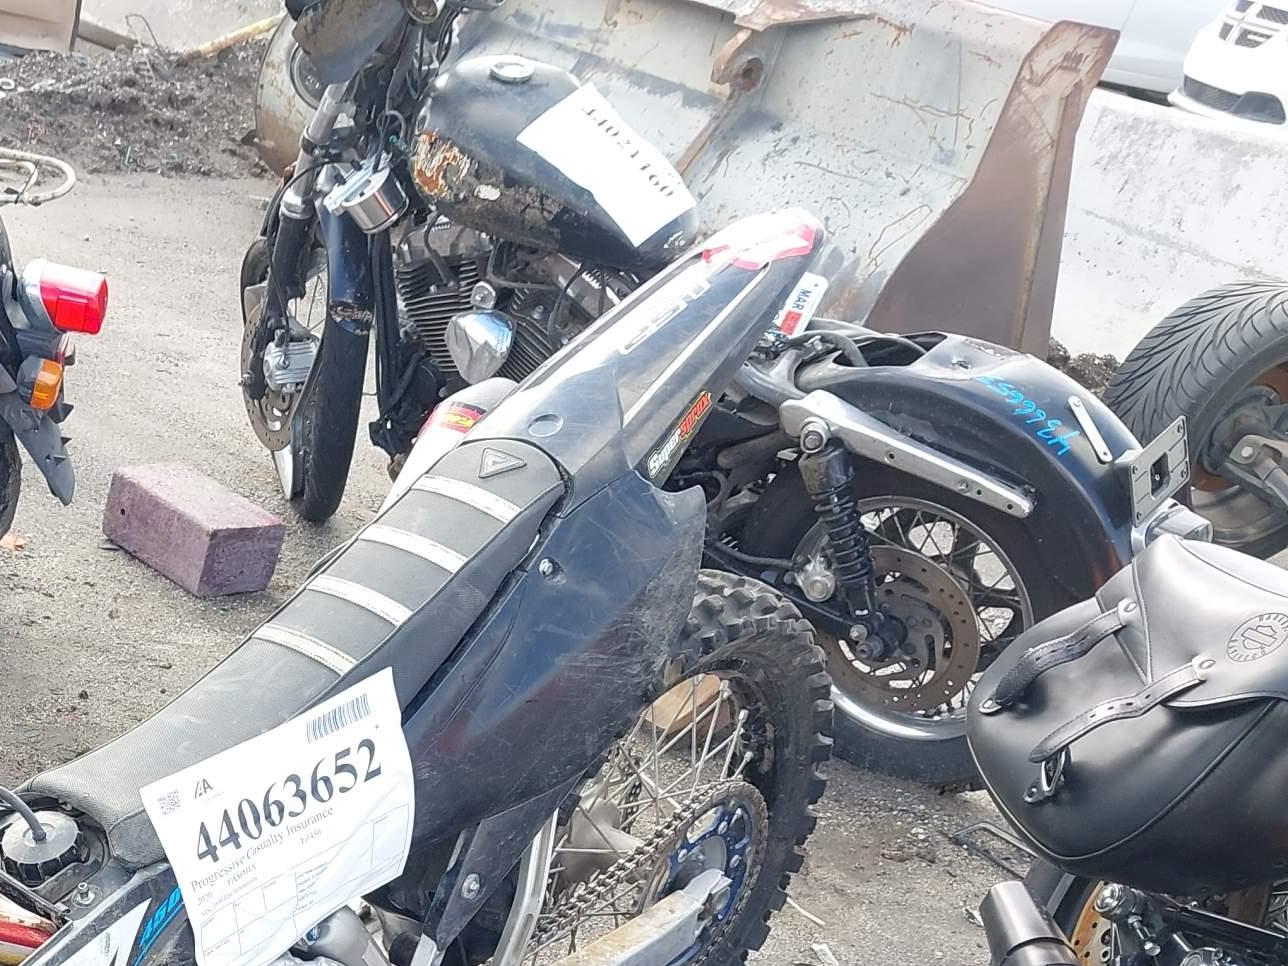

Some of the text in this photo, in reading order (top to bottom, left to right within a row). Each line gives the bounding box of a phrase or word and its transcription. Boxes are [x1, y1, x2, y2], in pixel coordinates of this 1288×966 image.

[792, 288, 812, 310] MAR
[197, 738, 382, 863] 44063652
[191, 807, 334, 892] Progressive Casualty Insurance
